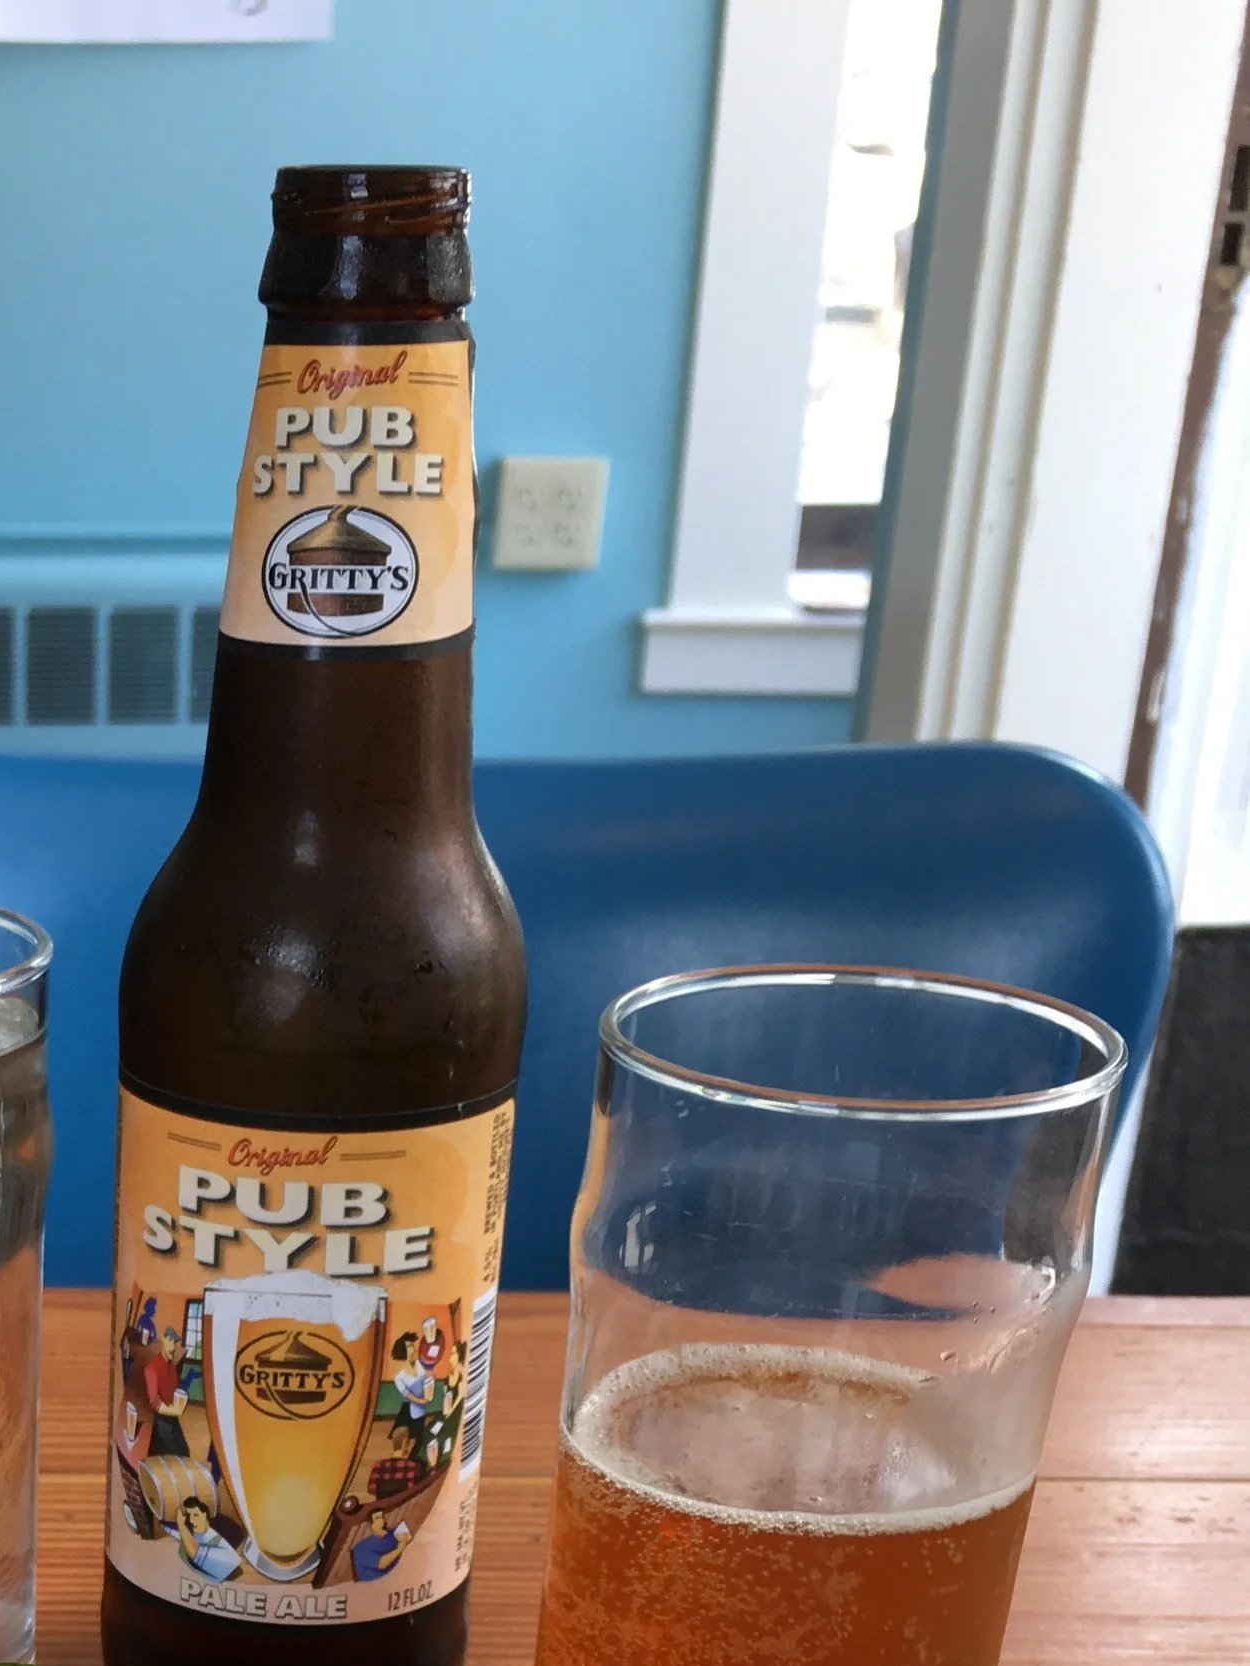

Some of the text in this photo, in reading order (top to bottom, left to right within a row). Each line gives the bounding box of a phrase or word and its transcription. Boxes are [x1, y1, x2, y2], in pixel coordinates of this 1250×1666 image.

[297, 350, 408, 400] Original
[275, 405, 417, 450] PUB
[252, 452, 444, 497] STYLE
[268, 562, 410, 591] GRITTY'S
[227, 1135, 339, 1176] Original
[178, 1164, 390, 1228] PUB
[142, 1204, 435, 1277] STYLE
[239, 1363, 346, 1389] GRITTY'S
[180, 1576, 348, 1620] PALE ALE
[387, 1591, 401, 1611] 12
